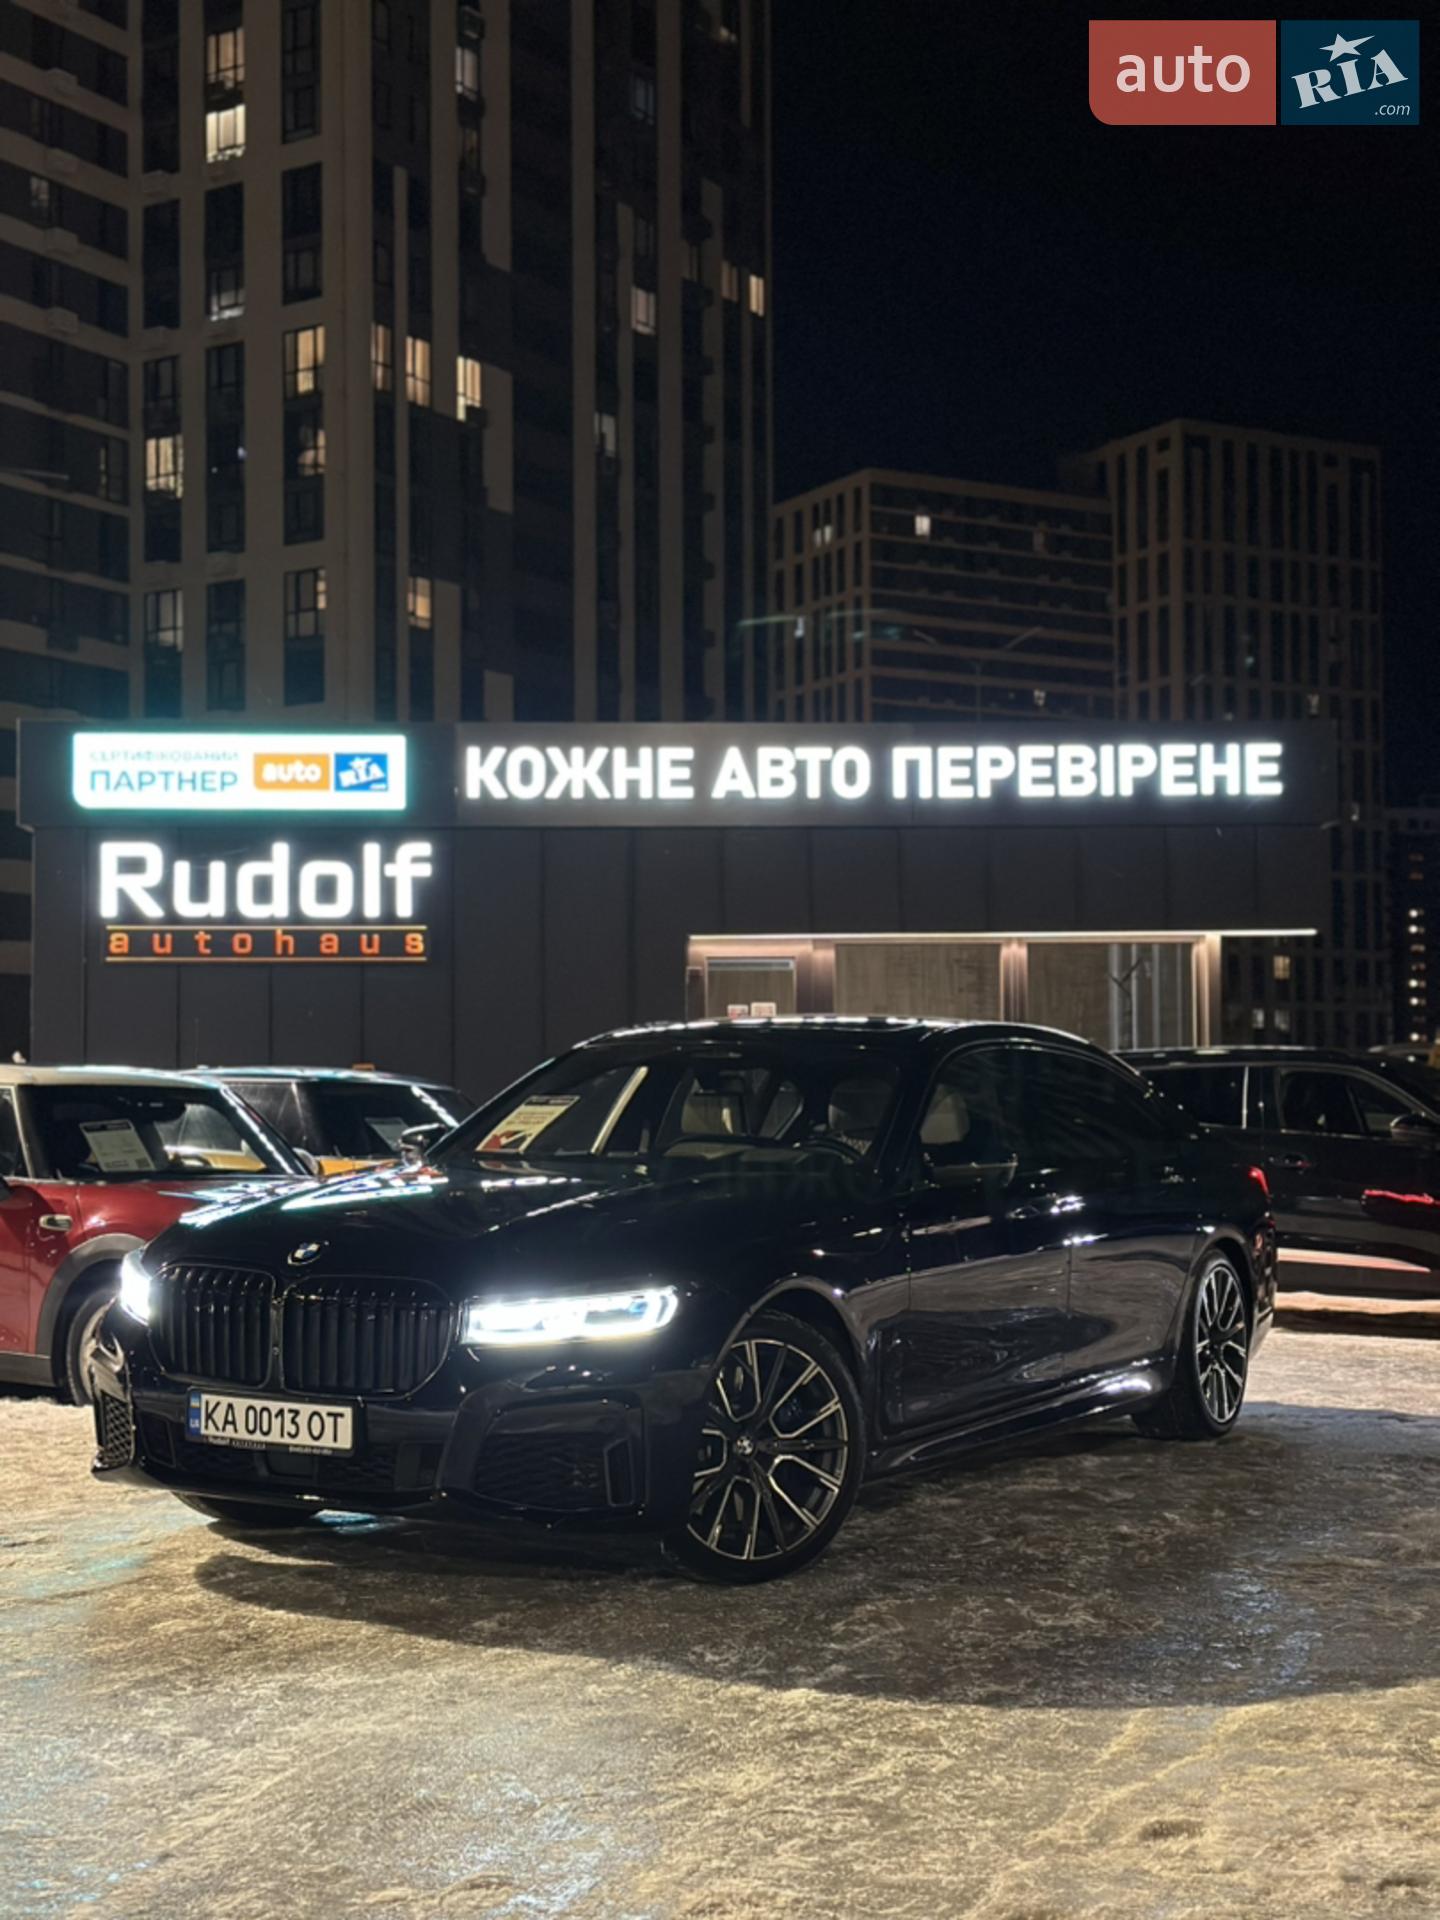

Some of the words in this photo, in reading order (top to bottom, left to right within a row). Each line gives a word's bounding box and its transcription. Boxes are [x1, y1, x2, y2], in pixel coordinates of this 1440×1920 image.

[89, 769, 239, 792] ПАРТНЕР
[262, 760, 322, 783] auto
[465, 746, 695, 800] КОЖНЕ
[711, 746, 872, 800] АВТО
[891, 743, 1284, 799] ПЕРЕВІРЕНЕ
[99, 841, 433, 919] Rudolf
[108, 928, 425, 955] autohaus
[203, 1399, 238, 1434] KA
[244, 1405, 300, 1440] 0013
[307, 1410, 345, 1444] OT
